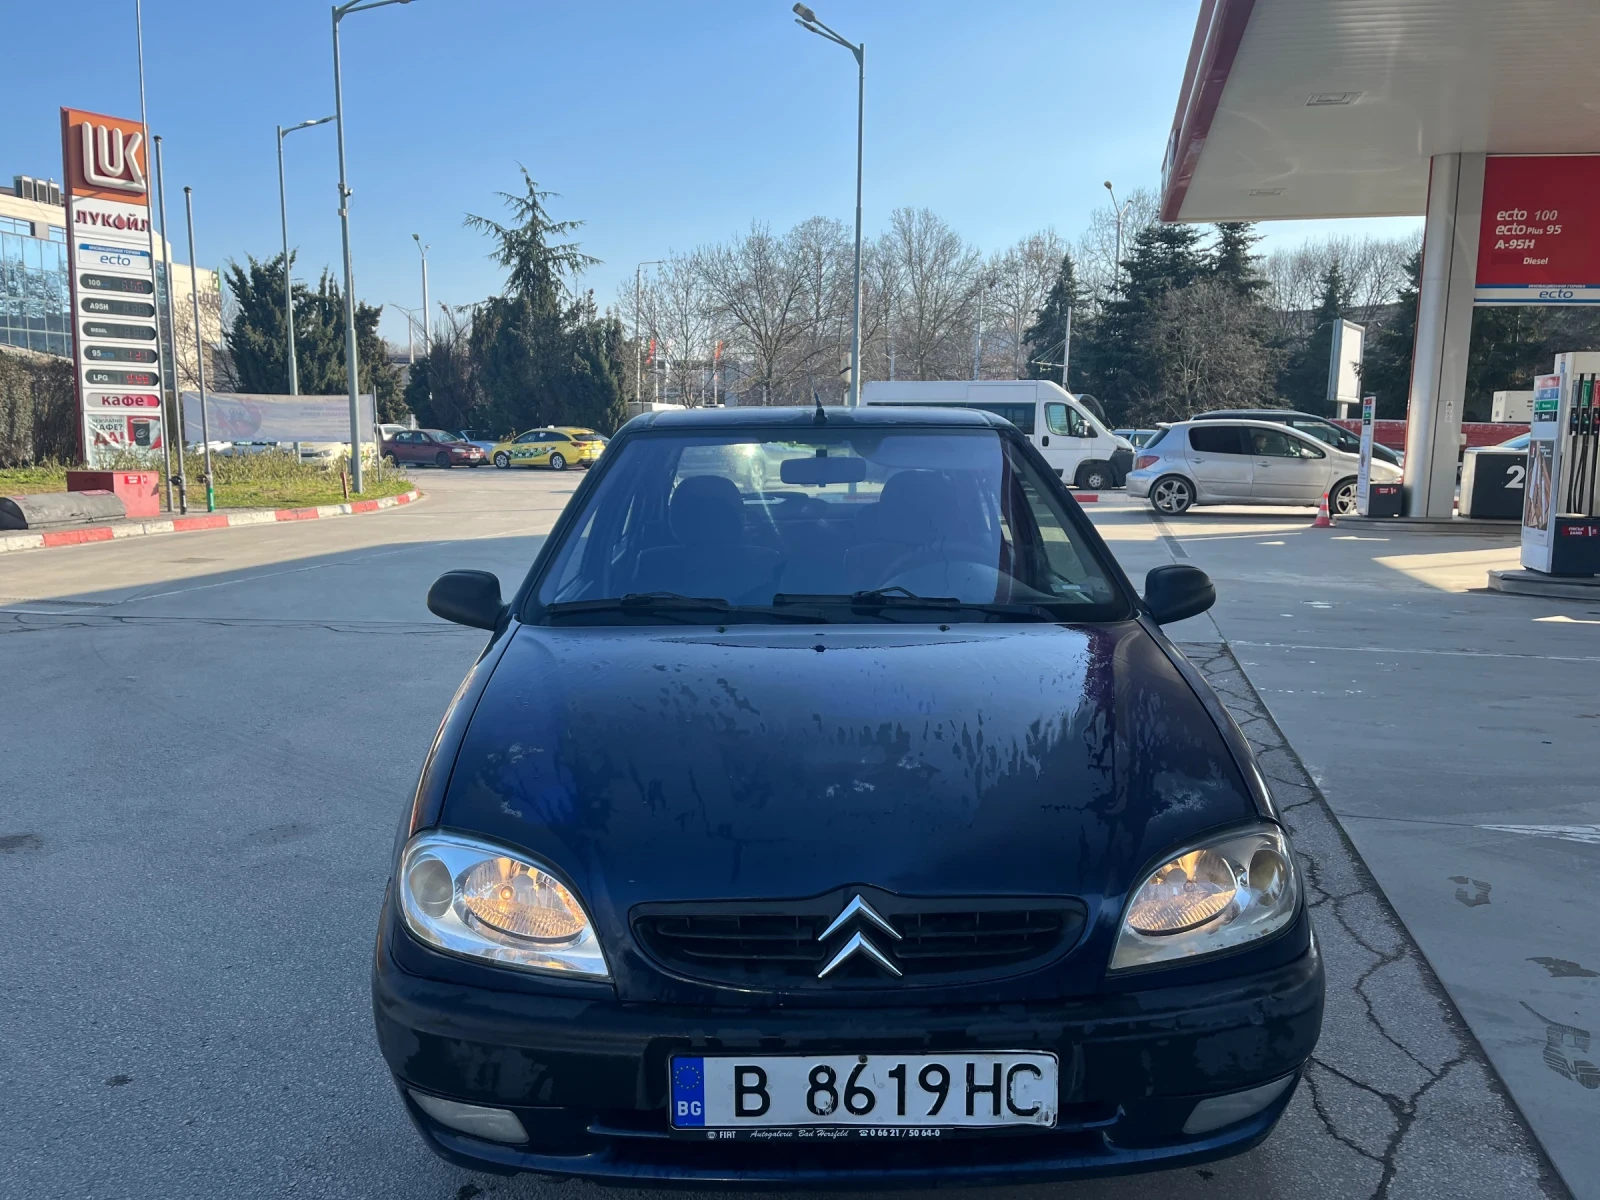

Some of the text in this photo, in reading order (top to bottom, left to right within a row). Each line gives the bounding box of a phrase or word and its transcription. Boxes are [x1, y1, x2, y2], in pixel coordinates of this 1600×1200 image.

[1497, 208, 1558, 221] ecto 100
[1495, 222, 1562, 235] ecto Plus 95
[1494, 239, 1535, 250] A-95H
[100, 254, 131, 266] ecto
[1523, 257, 1549, 265] Diesel
[1539, 289, 1574, 299] ecto
[91, 349, 102, 357] 95
[1505, 465, 1526, 489] 2
[677, 1101, 702, 1116] BG
[734, 1064, 771, 1118] B
[719, 1130, 736, 1139] FIAT
[750, 1129, 793, 1140] Autogalerie
[798, 1129, 815, 1138] Bad
[816, 1129, 849, 1140] Hersfeld
[870, 1129, 876, 1137] 0
[877, 1129, 888, 1137] 66
[889, 1129, 899, 1137] 21
[908, 1129, 919, 1137] 50
[921, 1129, 940, 1137] 64-0
